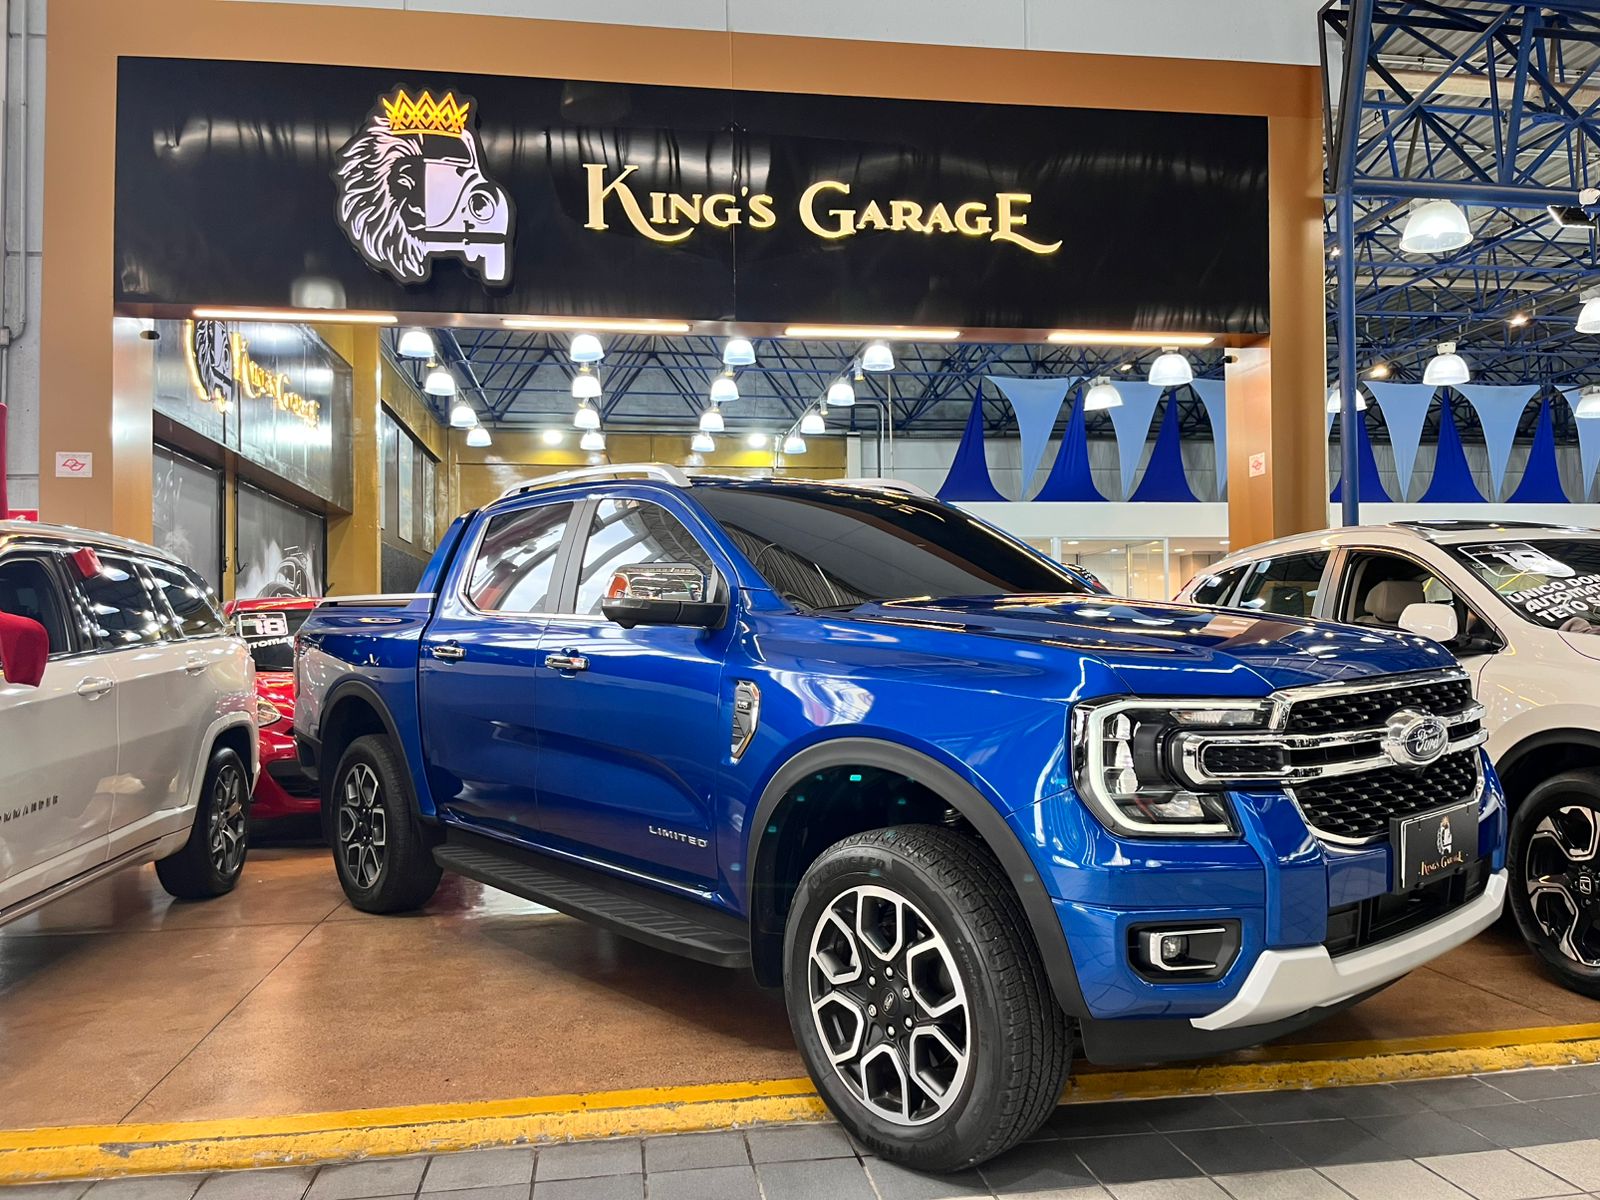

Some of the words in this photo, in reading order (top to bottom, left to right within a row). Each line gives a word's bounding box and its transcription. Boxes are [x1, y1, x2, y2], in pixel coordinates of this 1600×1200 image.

[583, 164, 777, 242] KING'S
[799, 180, 1063, 254] GARAGE
[1507, 581, 1566, 603] UNICO
[1536, 600, 1589, 622] TETO
[1414, 728, 1442, 753] Ford
[0, 795, 58, 822] MMANDER
[648, 825, 708, 848] LIMITED
